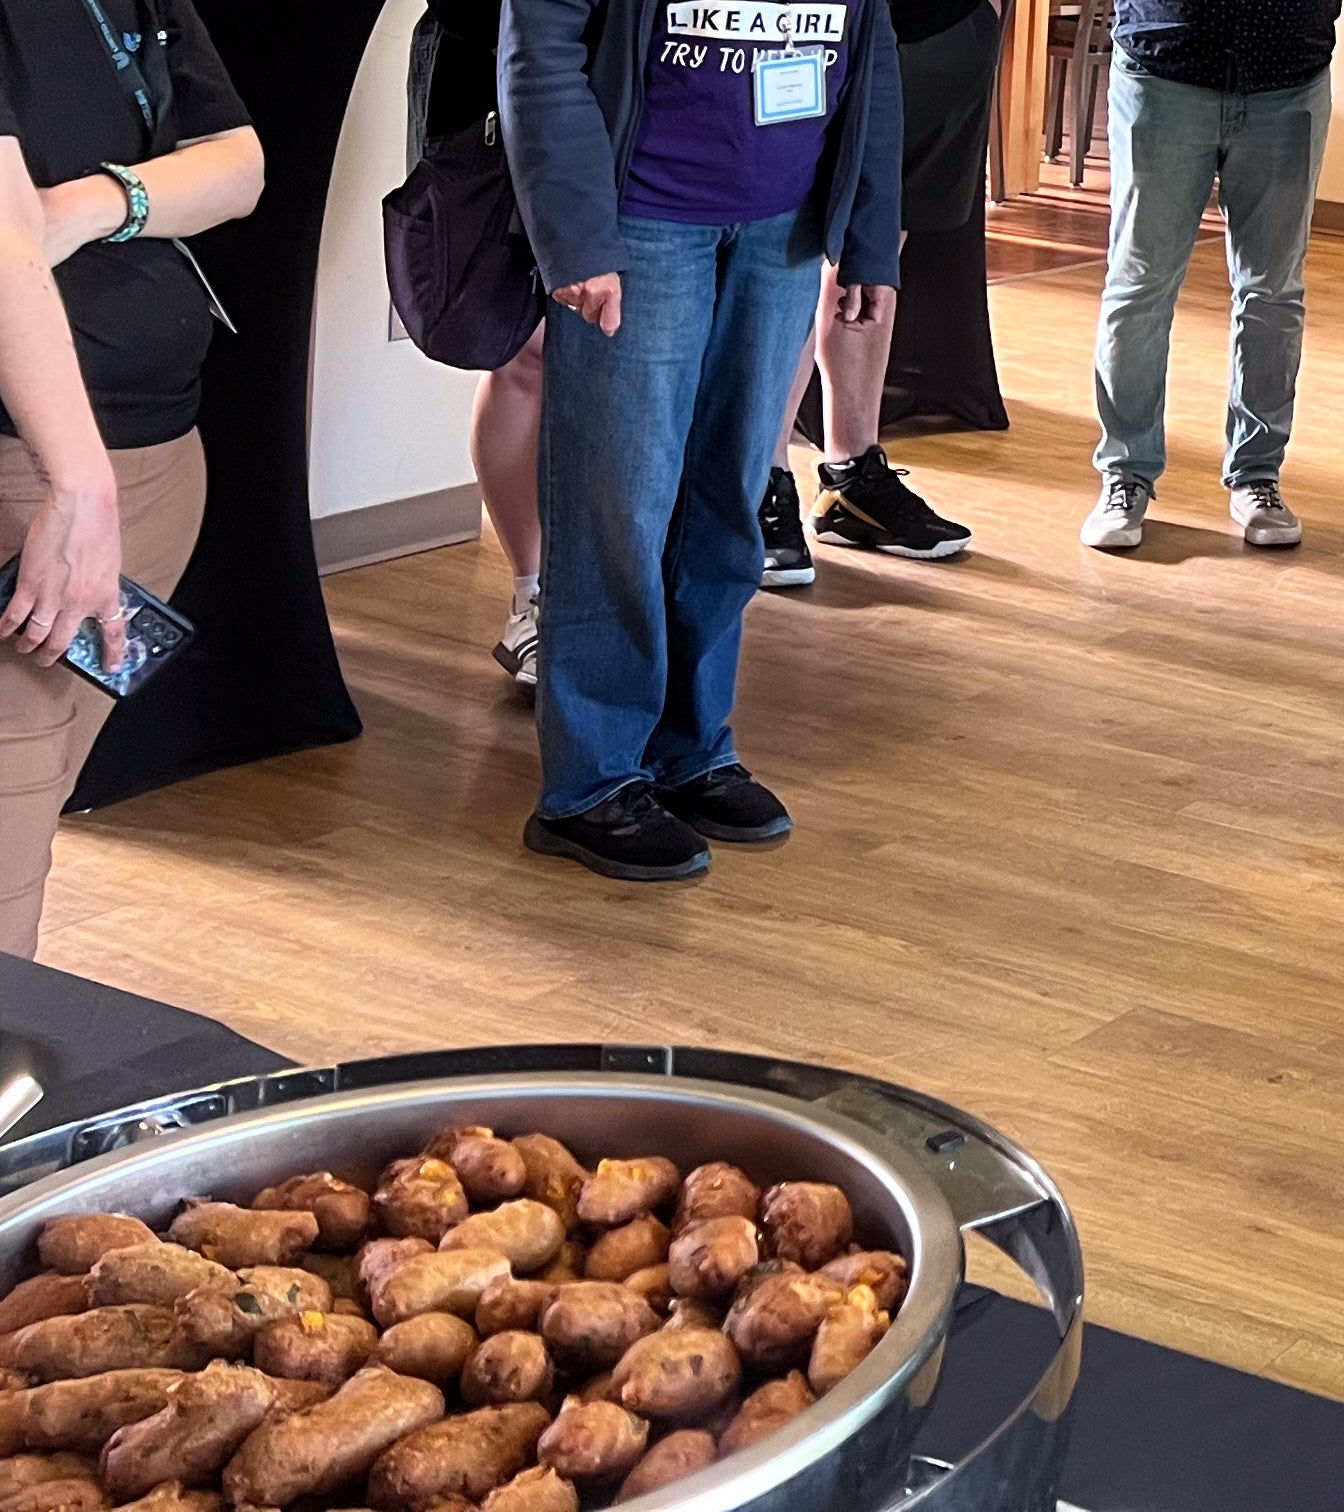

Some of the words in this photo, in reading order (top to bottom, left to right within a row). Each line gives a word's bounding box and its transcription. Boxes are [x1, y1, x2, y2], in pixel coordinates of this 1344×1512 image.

[670, 9, 742, 33] LIKE
[749, 12, 766, 33] A
[660, 41, 708, 68] TRY
[719, 47, 746, 73] TO
